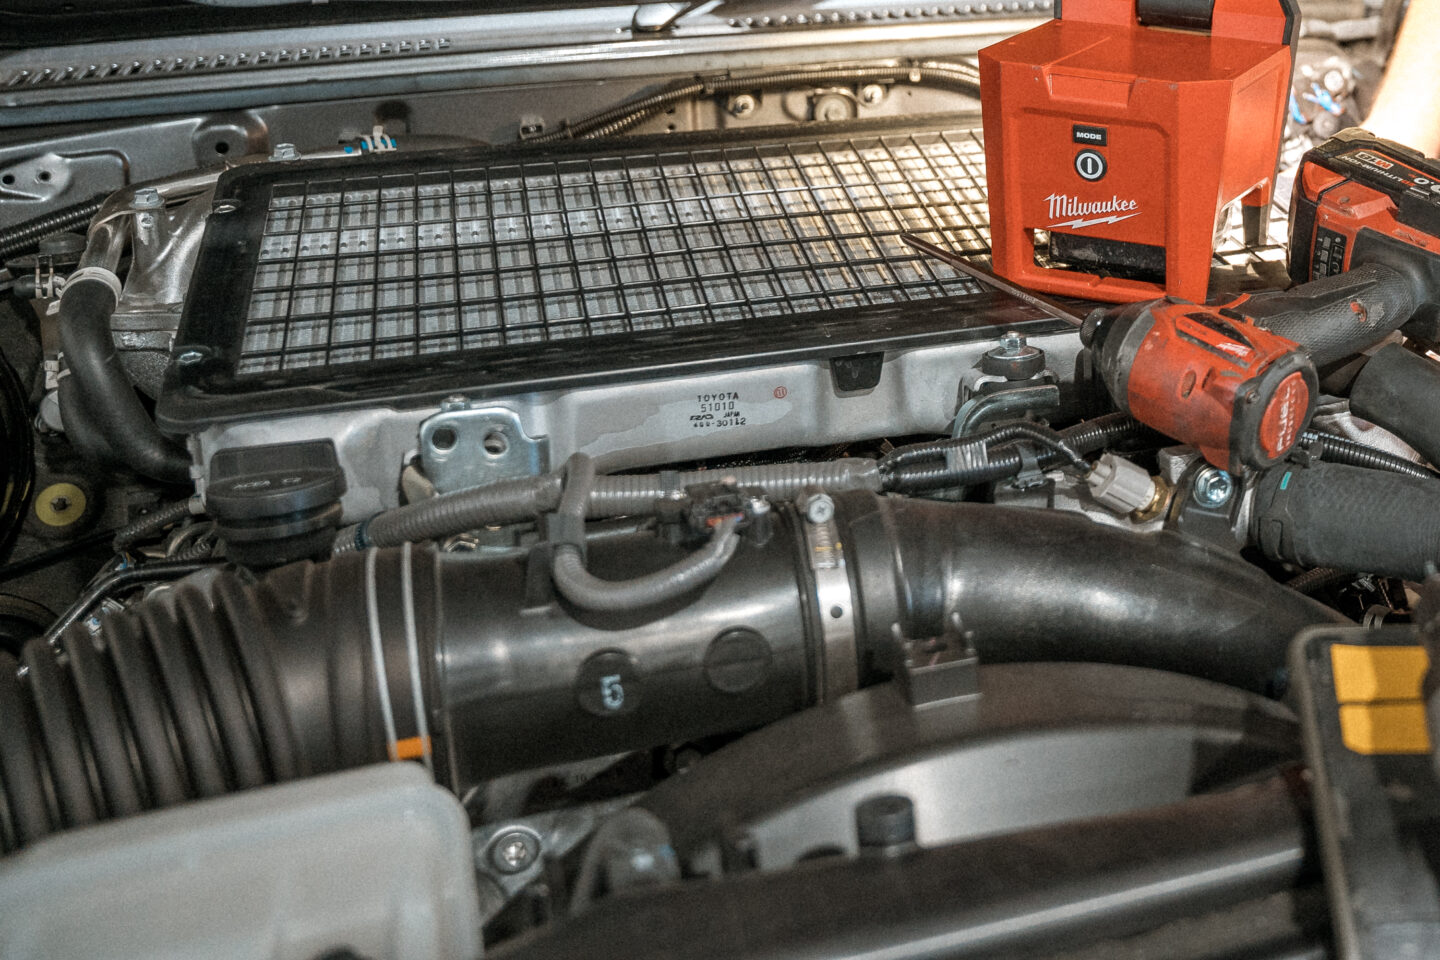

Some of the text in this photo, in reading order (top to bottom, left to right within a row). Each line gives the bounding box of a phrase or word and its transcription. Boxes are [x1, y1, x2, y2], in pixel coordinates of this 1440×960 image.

[1076, 131, 1102, 141] MODE
[1043, 192, 1139, 219] Milwaukee
[697, 392, 739, 402] TOYOTA
[701, 401, 735, 413] 51010
[601, 673, 625, 710] 5
